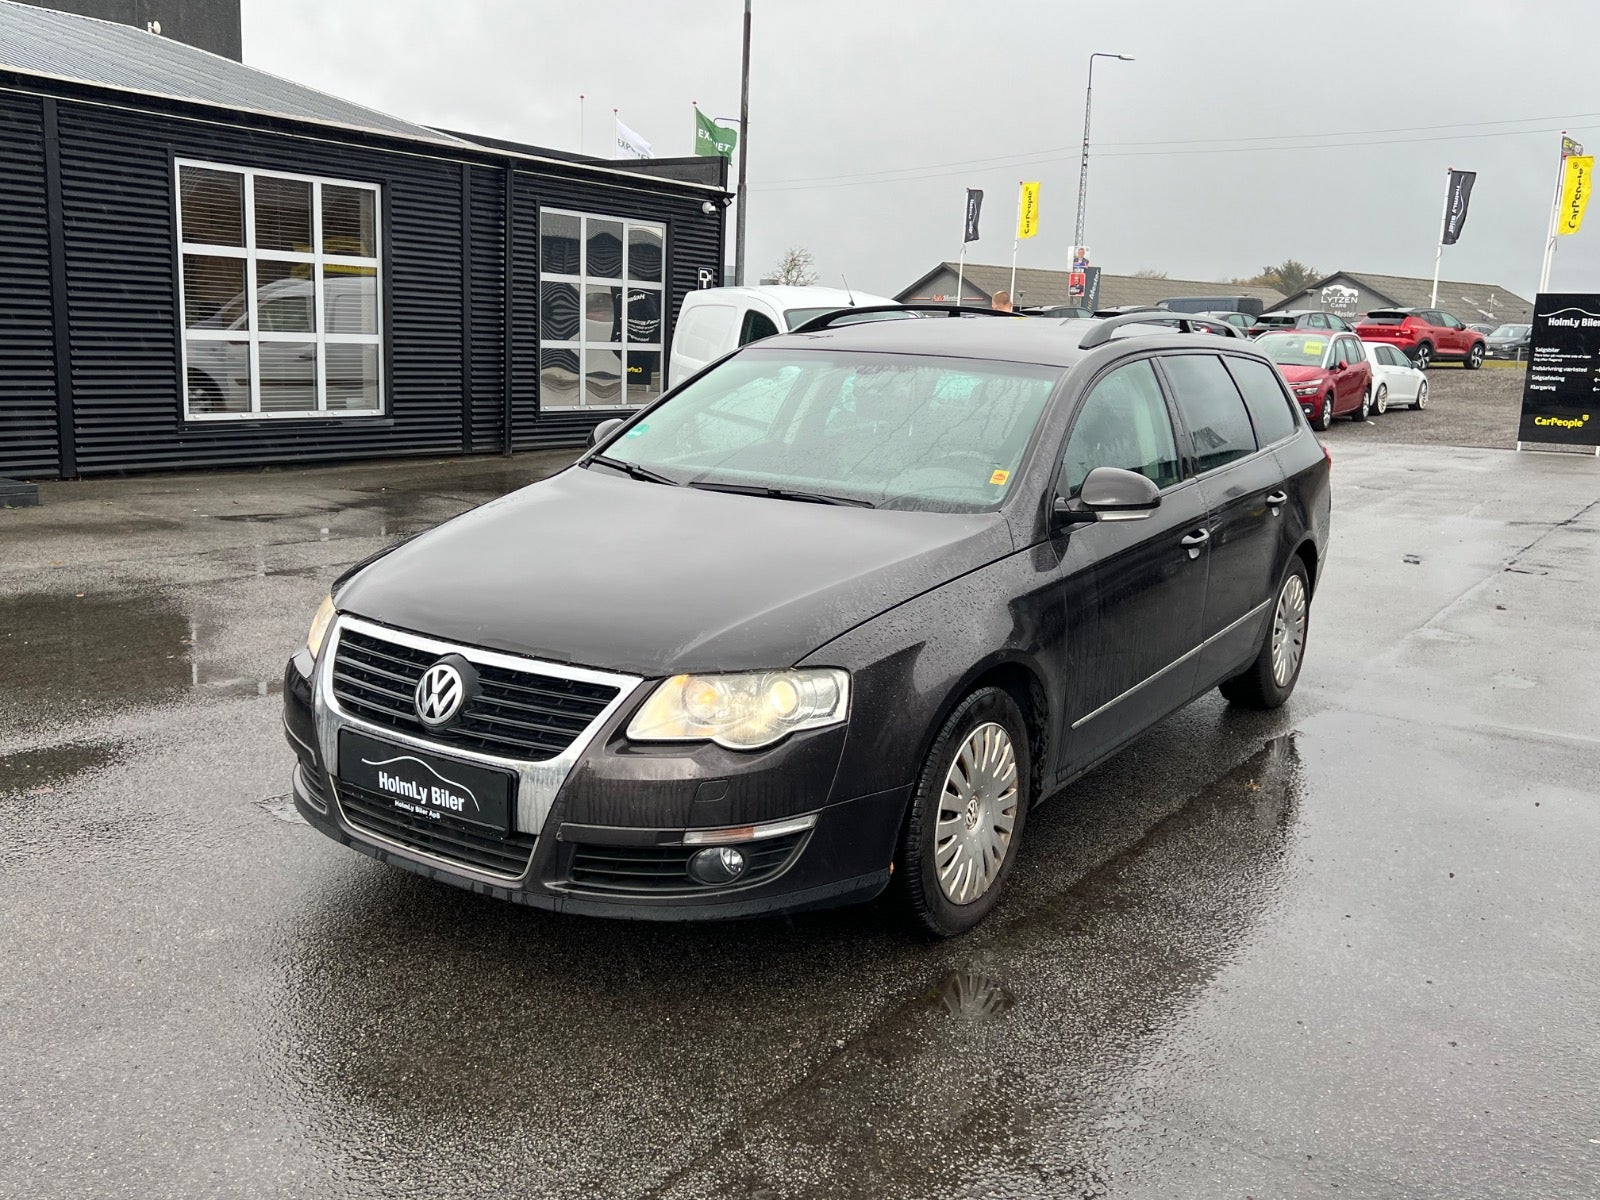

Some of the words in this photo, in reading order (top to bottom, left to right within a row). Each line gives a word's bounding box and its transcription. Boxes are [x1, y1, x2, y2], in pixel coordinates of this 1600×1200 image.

[1548, 317, 1580, 329] HolmLy
[1534, 416, 1584, 429] CarPeople
[378, 771, 428, 804] HolmLy
[431, 786, 465, 812] Biler
[394, 800, 414, 812] HolmLy
[415, 806, 428, 815] Biler
